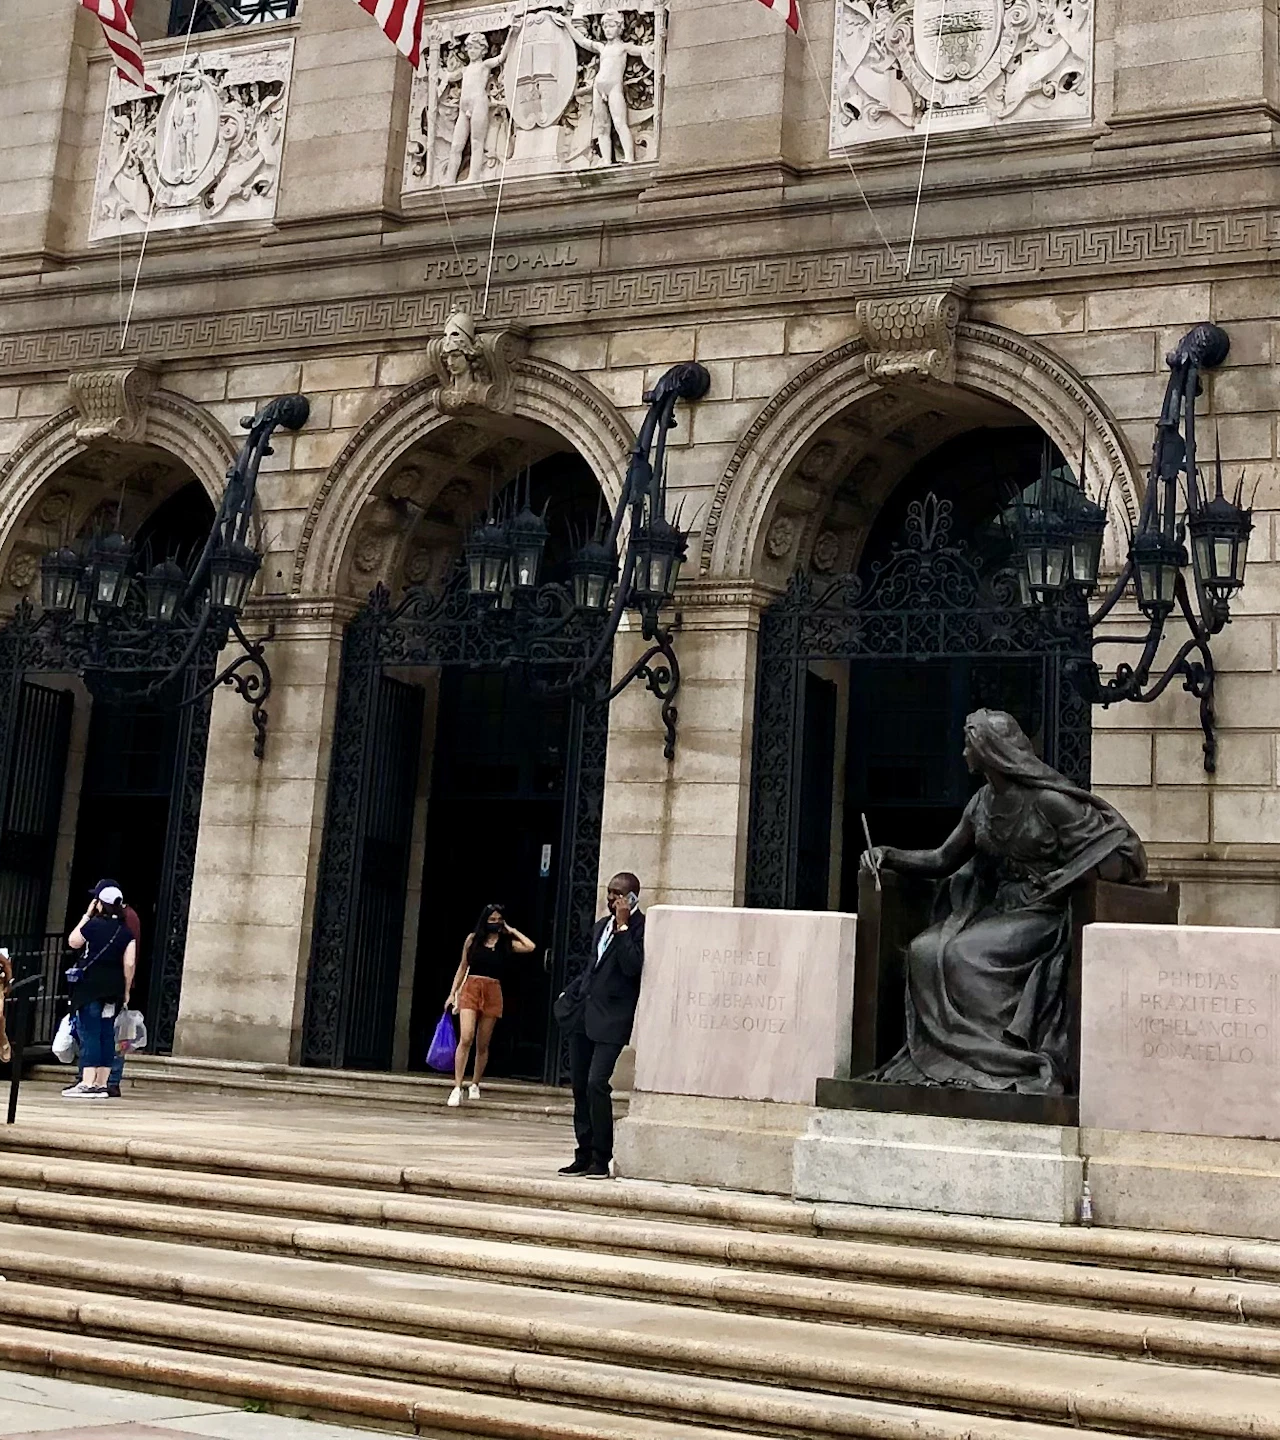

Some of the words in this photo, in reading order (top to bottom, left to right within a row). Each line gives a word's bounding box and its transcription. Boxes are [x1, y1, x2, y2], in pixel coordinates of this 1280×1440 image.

[702, 949, 775, 967] RAPHAEL
[711, 970, 767, 986] TITIAN
[1158, 971, 1239, 990] PHIDIAS
[688, 991, 786, 1011] REMBRANDT
[1140, 993, 1257, 1014] PRAXITELES
[1131, 1016, 1268, 1040] MICHELANGELO
[1143, 1042, 1253, 1063] DONATELLO
